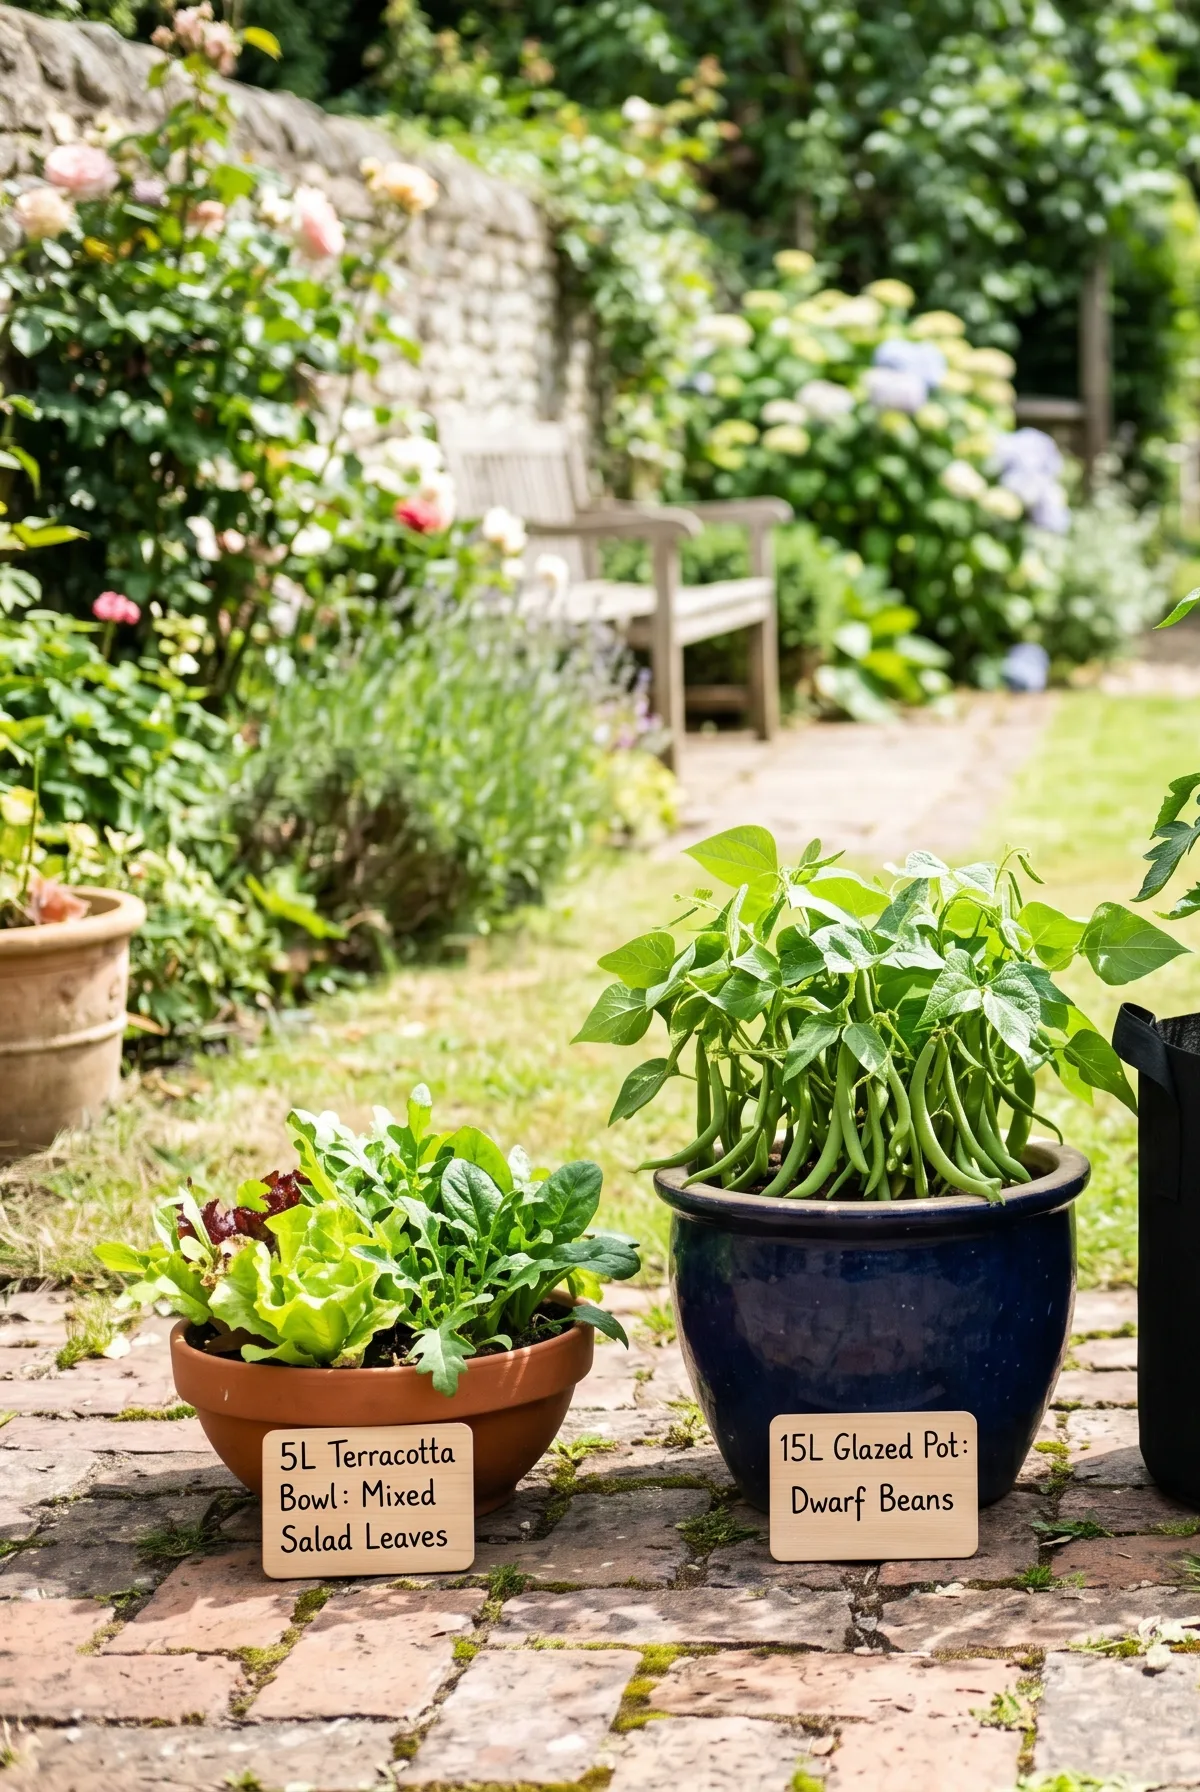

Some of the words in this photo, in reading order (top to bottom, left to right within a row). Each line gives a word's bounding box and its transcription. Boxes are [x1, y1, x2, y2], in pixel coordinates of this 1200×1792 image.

[280, 1440, 317, 1472] 5L
[327, 1436, 456, 1469] Terracotta
[780, 1433, 824, 1462] 15L
[833, 1432, 914, 1461] Glazed
[924, 1430, 968, 1459] Pot:
[280, 1482, 349, 1512] Bowl:
[362, 1477, 437, 1508] Mixed
[791, 1485, 867, 1522] Dwarf
[879, 1482, 954, 1513] Beans
[280, 1522, 353, 1554] Salad
[365, 1522, 448, 1550] Leaves
